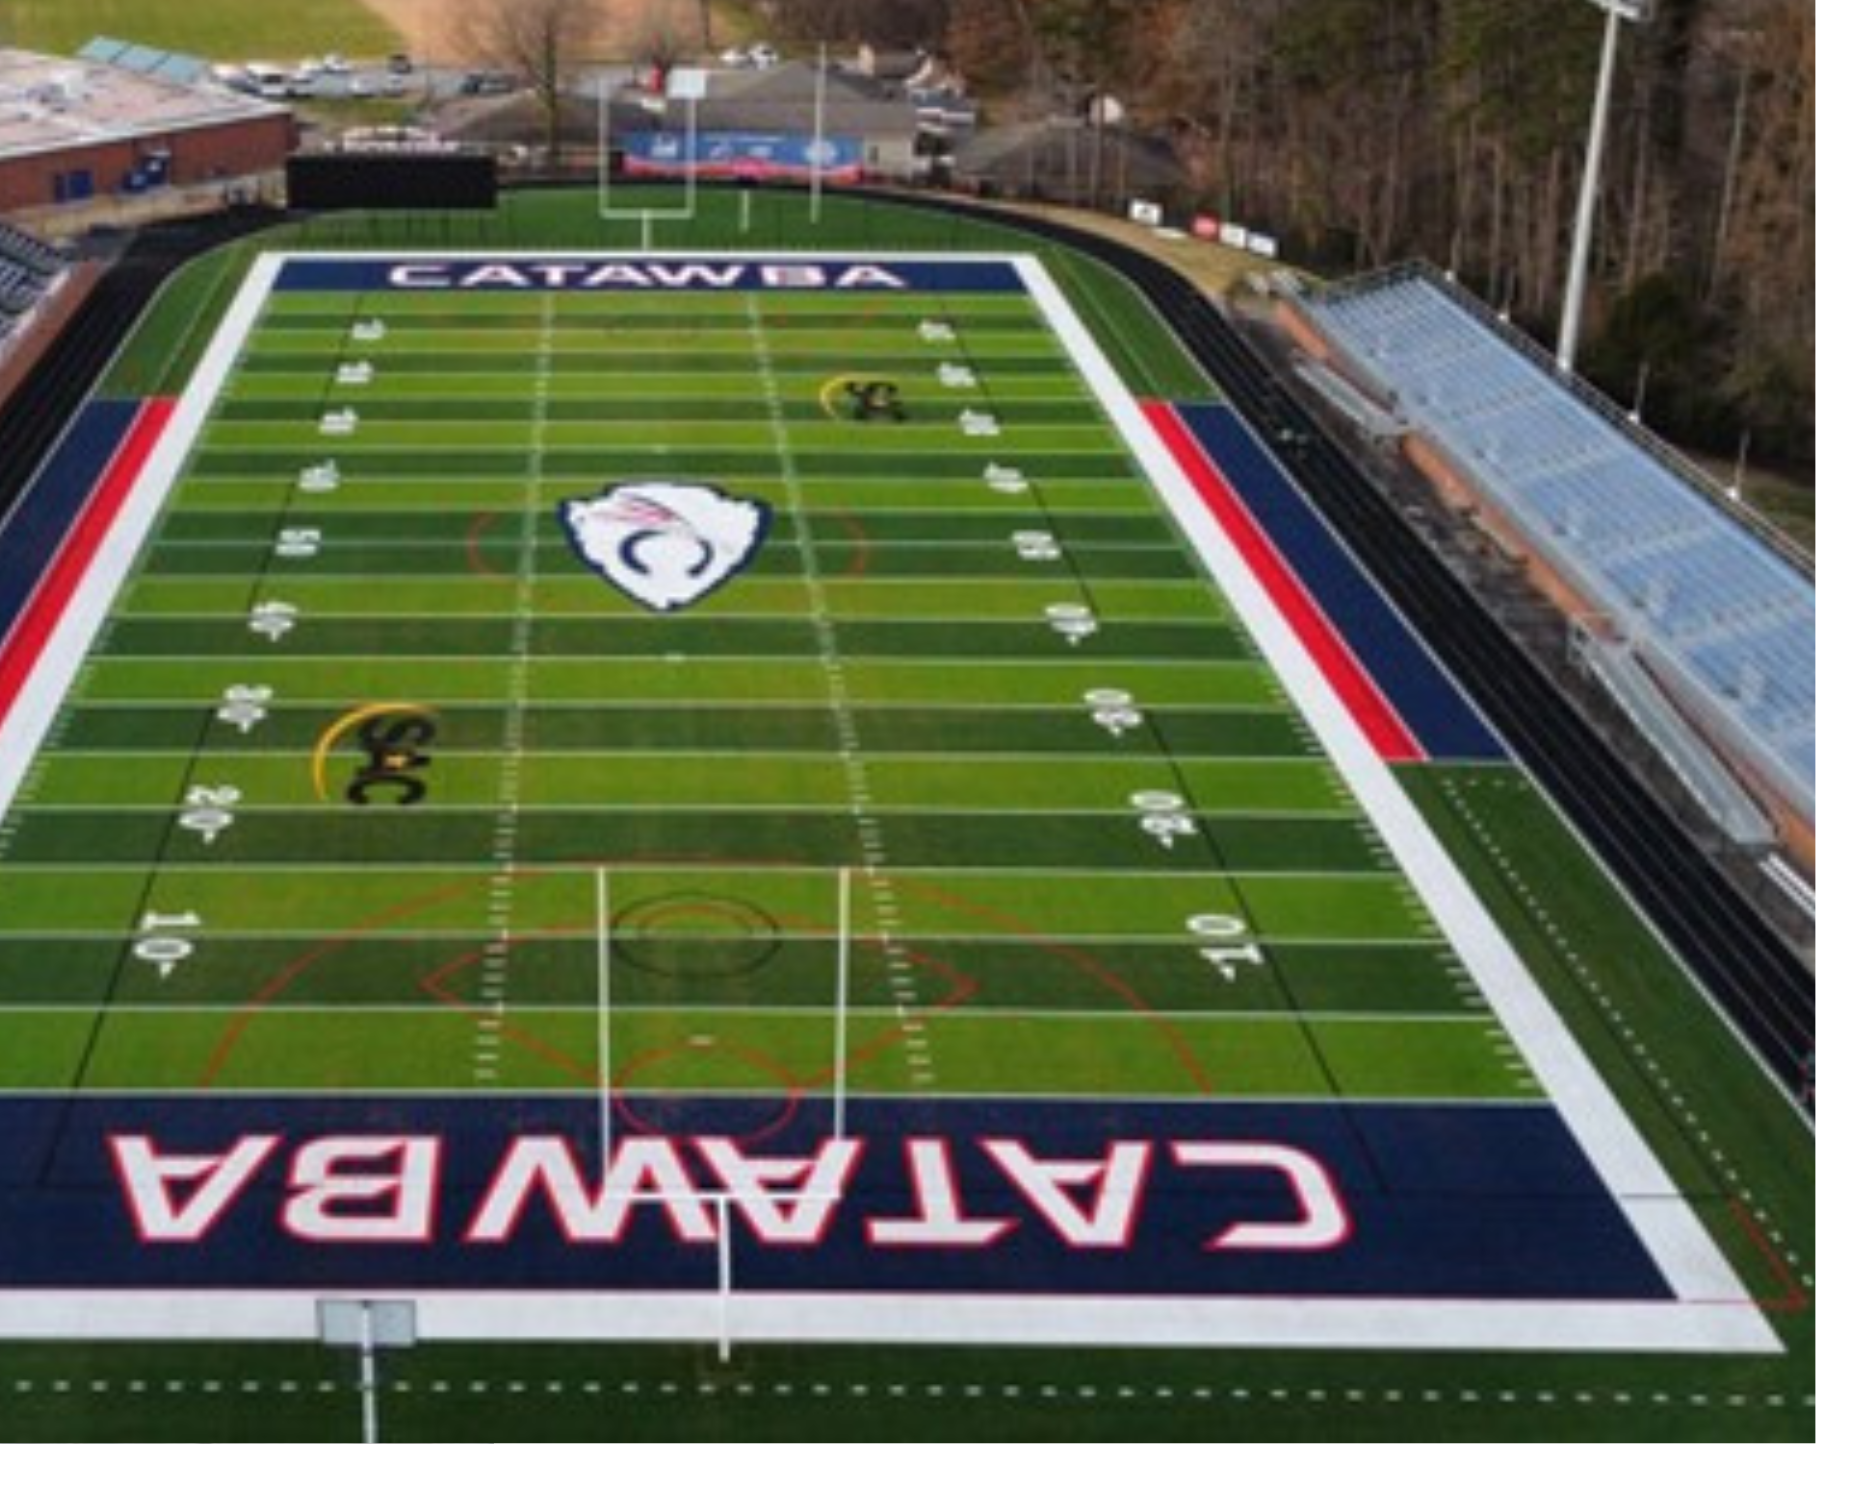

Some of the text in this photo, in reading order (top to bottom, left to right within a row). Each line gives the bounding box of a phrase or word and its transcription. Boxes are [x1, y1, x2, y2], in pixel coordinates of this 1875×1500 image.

[388, 264, 908, 287] CATAWBA
[177, 784, 243, 828] 20
[1128, 788, 1198, 836] 20
[131, 910, 202, 962] 10
[1184, 913, 1264, 966] 10
[107, 1132, 1358, 1252] CATAWBA
